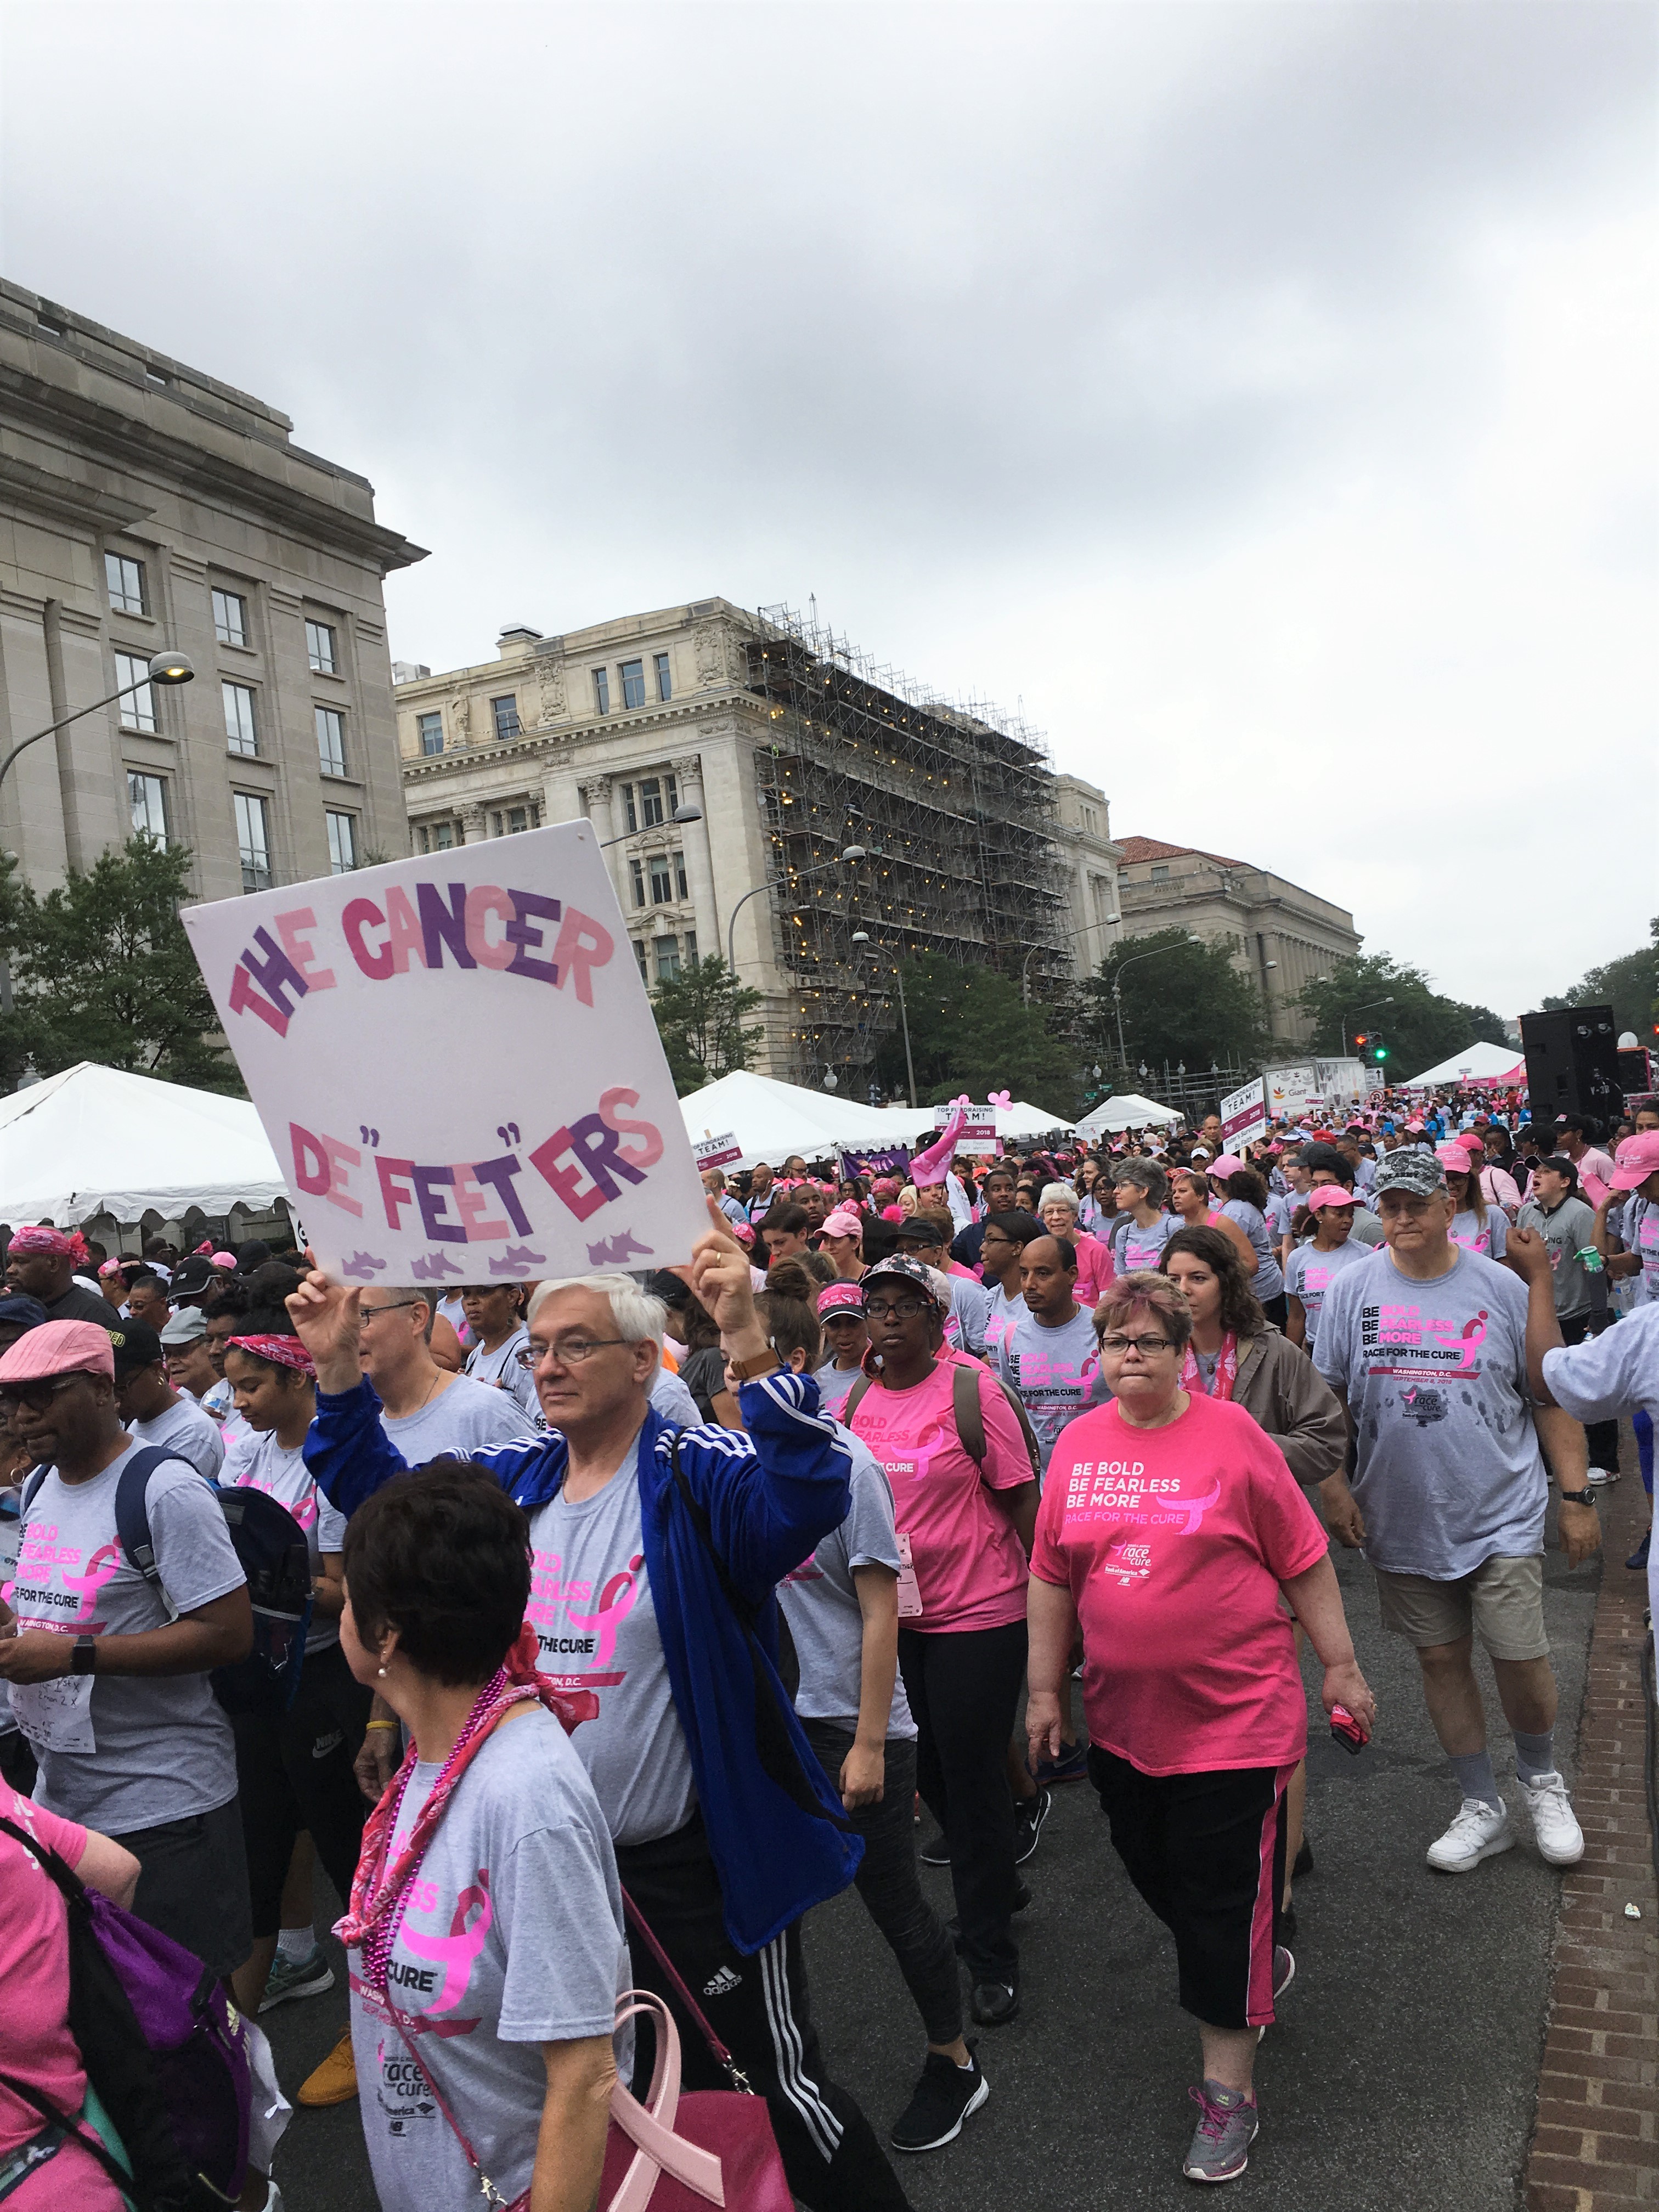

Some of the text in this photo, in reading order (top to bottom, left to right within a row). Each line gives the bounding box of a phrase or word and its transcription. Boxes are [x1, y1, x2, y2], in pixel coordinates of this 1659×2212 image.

[228, 883, 614, 1038] THE CANCER
[1222, 1081, 1261, 1107] TOP FUNDRAISING
[1289, 1088, 1307, 1097] Giant
[1228, 1090, 1256, 1113] TEAM!
[1240, 1122, 1262, 1137] Surviving
[698, 1139, 730, 1155] TEAM!
[701, 1133, 733, 1148] FUNDRAISING
[1241, 1136, 1252, 1146] Faith
[726, 1151, 738, 1159] 2018
[1362, 1305, 1420, 1318] BE BOLD
[1362, 1318, 1454, 1332] BE FEARLESS
[1362, 1332, 1421, 1345] BE MORE
[1010, 1352, 1048, 1364] BE BOLD
[1363, 1348, 1462, 1360] RACE FOR THE CURE
[1020, 1362, 1074, 1375] FEARLESS
[1392, 1368, 1437, 1377] WASHINGTON,
[1021, 1375, 1052, 1386] MORE
[1060, 1388, 1082, 1397] CURE
[1415, 1397, 1437, 1406] race
[885, 1462, 914, 1472] CURE
[1071, 1461, 1144, 1476] BE BOLD
[1069, 1477, 1181, 1493] BE FEARLESS
[1066, 1493, 1141, 1508] BE MORE
[1065, 1511, 1184, 1525] RACE FOR THE CURE
[25, 1522, 58, 1542] BOLD
[20, 1542, 82, 1565] FEARLESS
[1122, 1548, 1149, 1558] race
[530, 1549, 562, 1573] OLD
[16, 1562, 52, 1584] MORE
[531, 1576, 592, 1602] ARLSS
[19, 1588, 80, 1609] FOR THE CURE
[538, 1635, 595, 1654] THE CURE
[386, 1959, 438, 1993] CURE
[703, 1976, 742, 1996] adidas
